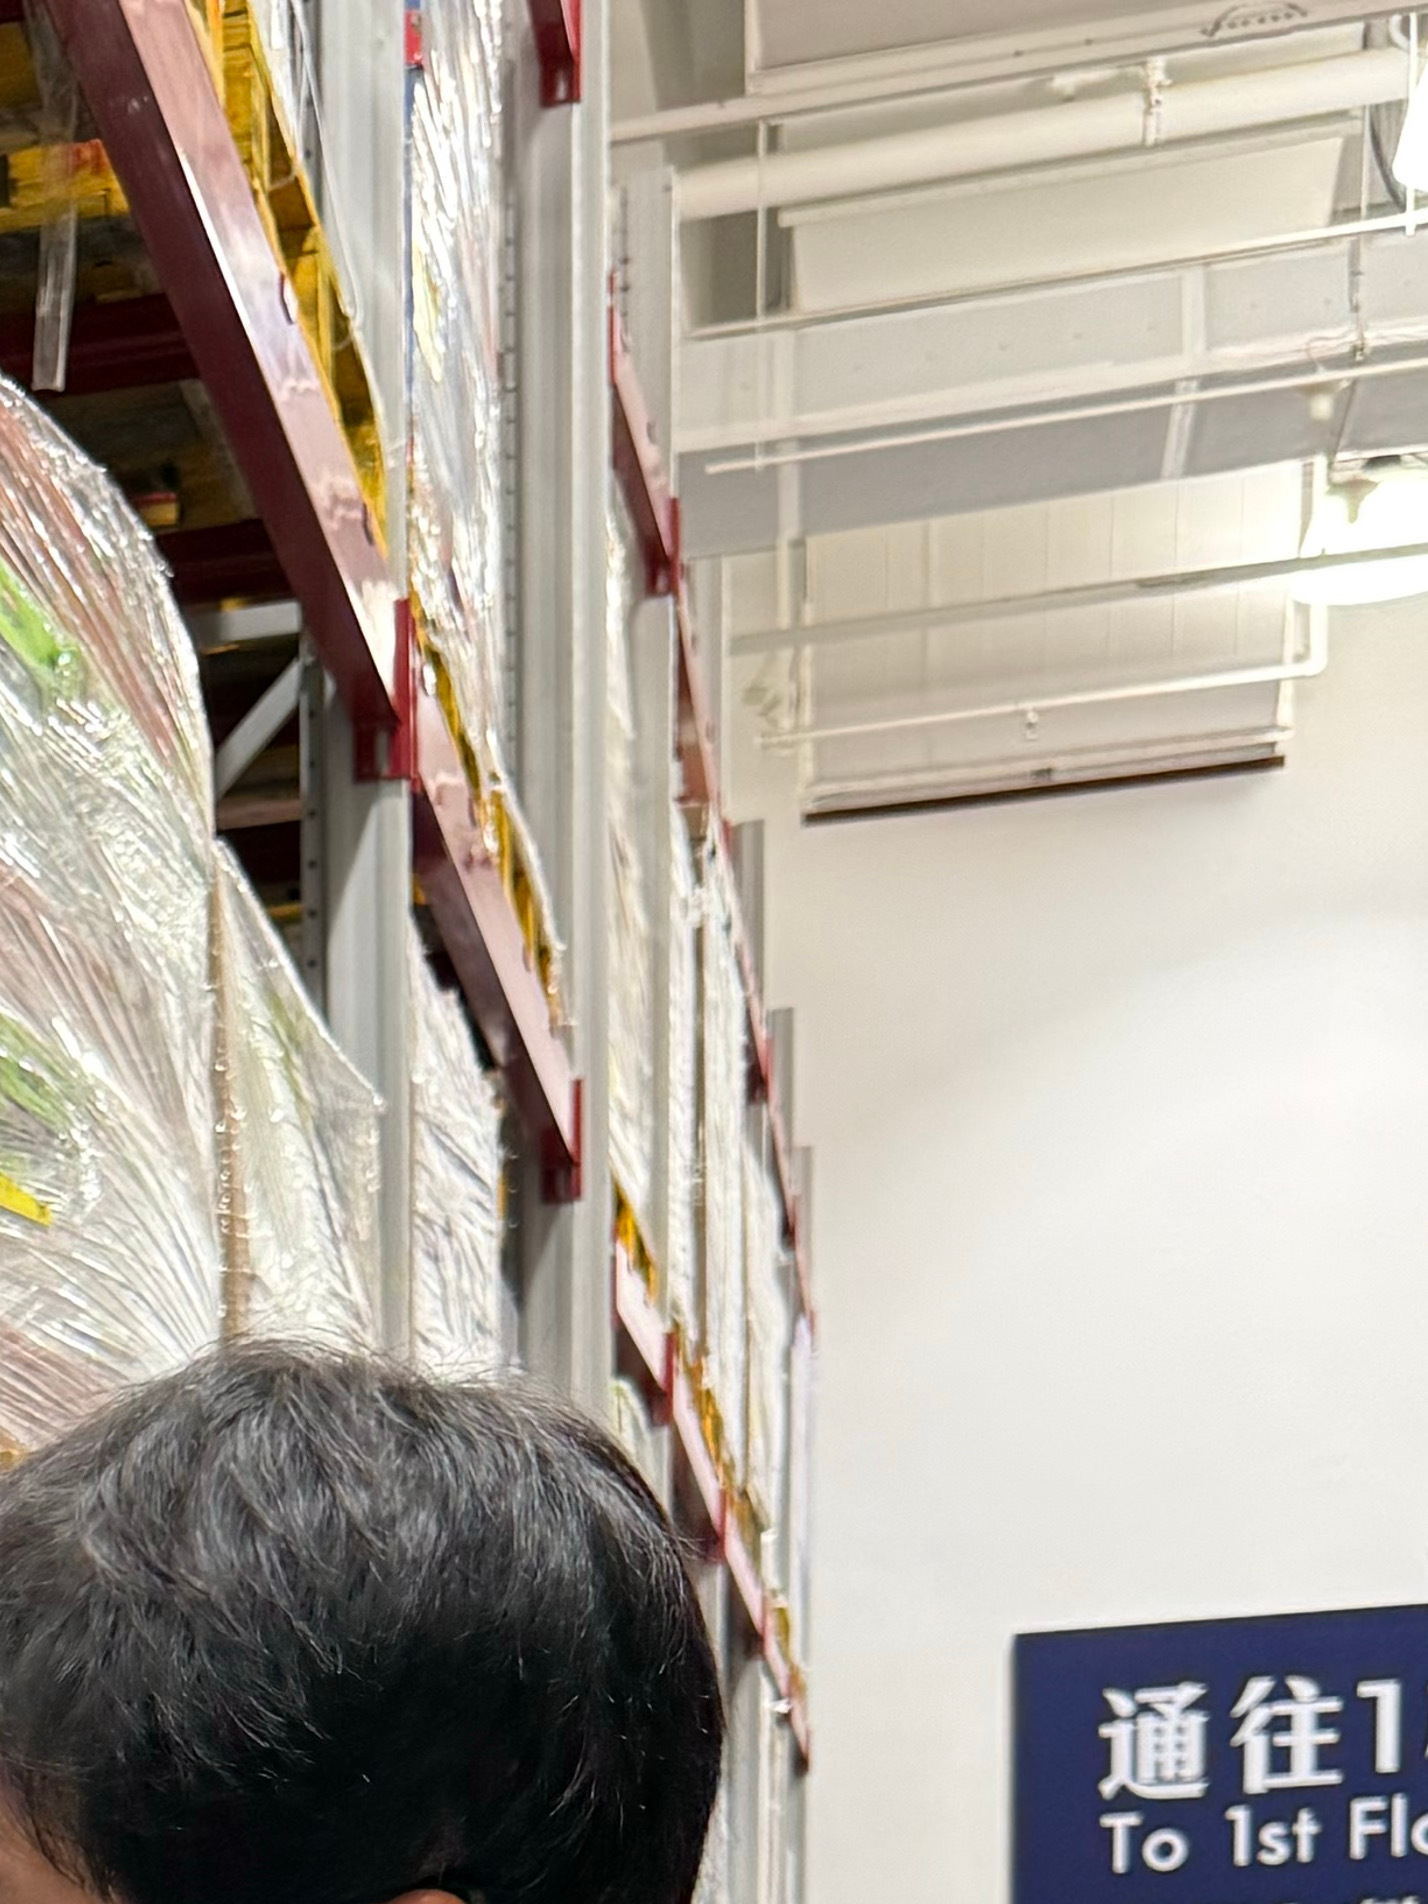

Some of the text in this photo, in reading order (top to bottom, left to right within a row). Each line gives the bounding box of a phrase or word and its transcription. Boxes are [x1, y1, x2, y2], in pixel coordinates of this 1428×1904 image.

[1097, 1675, 1428, 1800] 通往1
[1099, 1809, 1191, 1875] To
[1225, 1805, 1324, 1868] 1st
